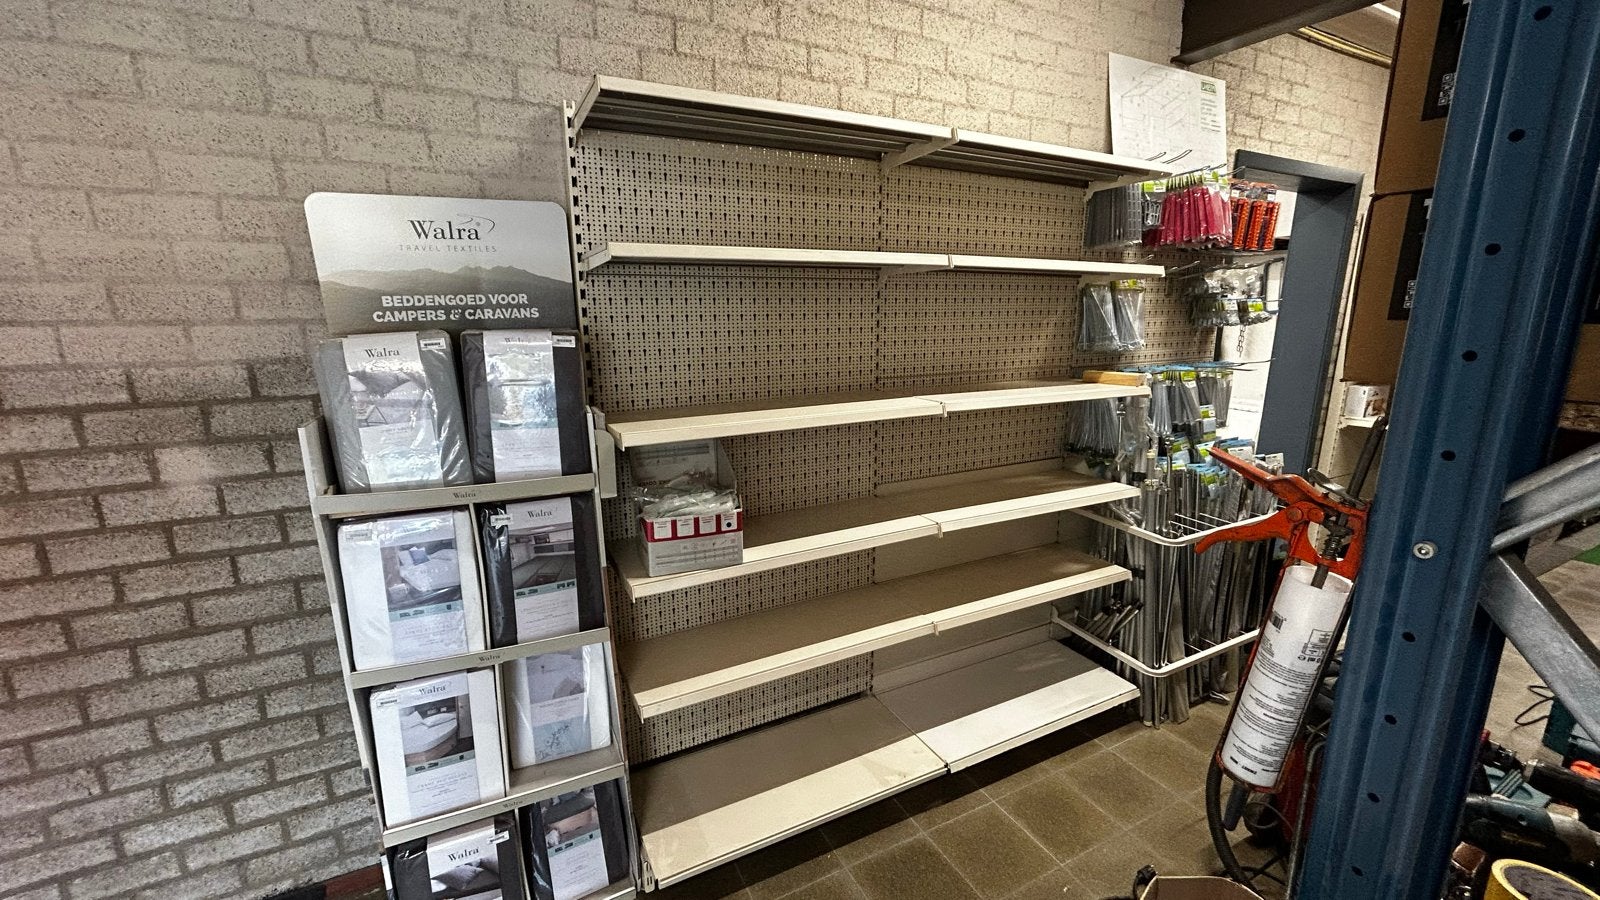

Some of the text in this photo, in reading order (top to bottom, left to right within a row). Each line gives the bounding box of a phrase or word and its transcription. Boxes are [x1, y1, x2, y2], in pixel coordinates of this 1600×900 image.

[407, 218, 481, 240] Walra
[399, 244, 497, 253] TRAVEL TEXTILES
[381, 293, 529, 307] BEDDENGOED VOOR
[372, 307, 540, 323] CAMPERS & CARAVANS
[364, 346, 401, 359] Walra
[452, 491, 477, 499] Walra
[527, 509, 553, 519] Walra
[478, 653, 501, 662] Walra
[418, 684, 447, 696] Walra
[447, 847, 480, 861] Walra
